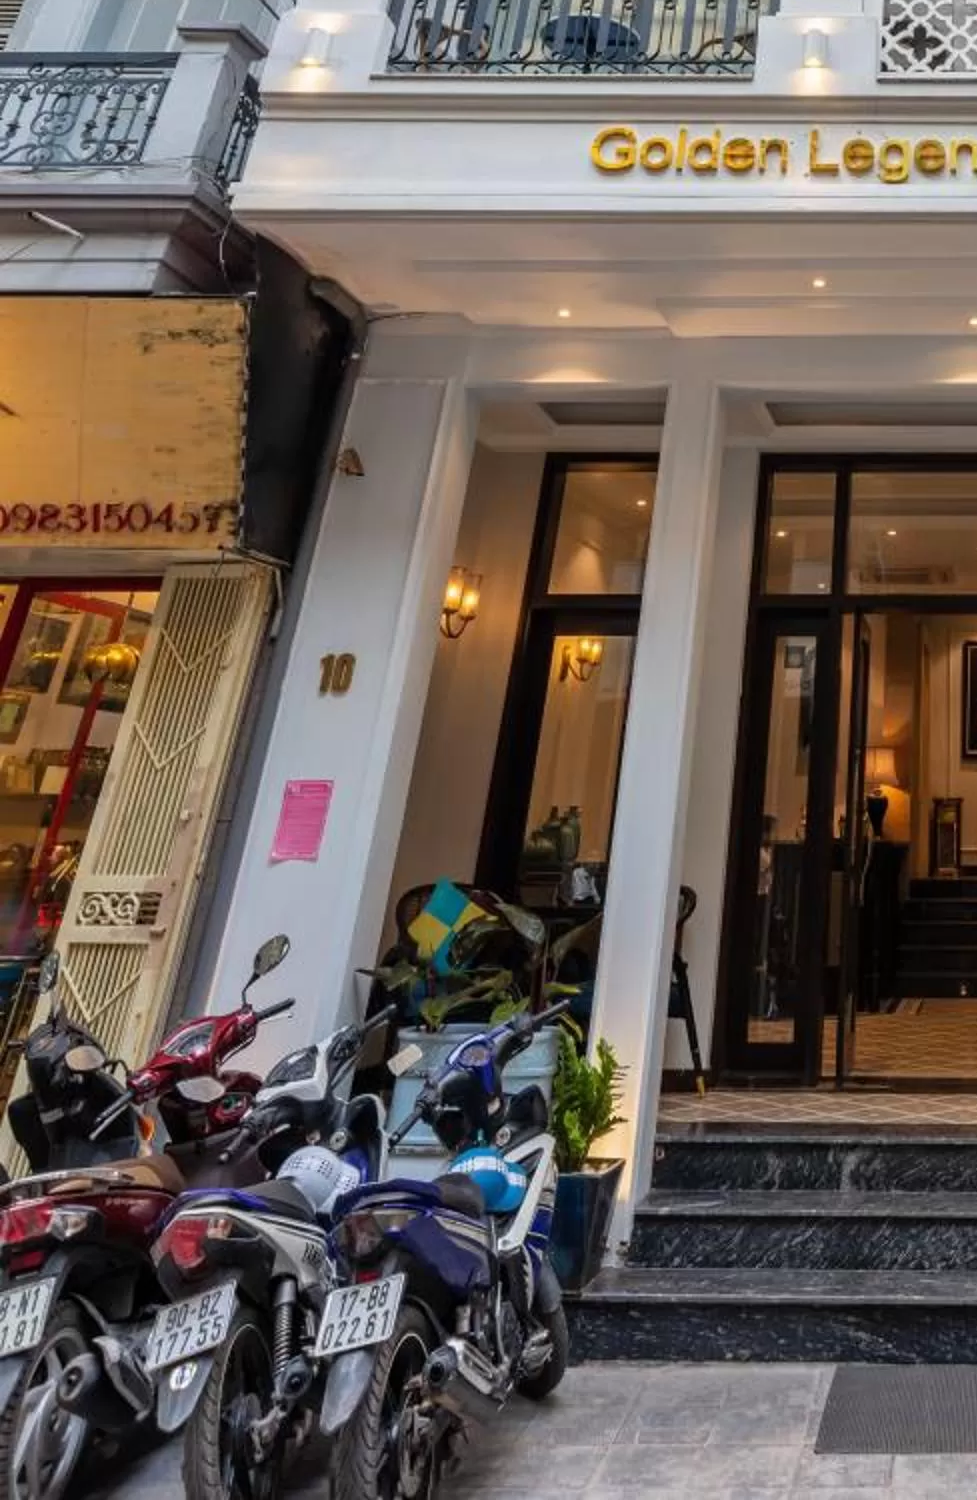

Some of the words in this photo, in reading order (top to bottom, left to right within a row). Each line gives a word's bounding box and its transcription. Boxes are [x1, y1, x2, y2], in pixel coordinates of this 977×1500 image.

[589, 127, 790, 174] Golden
[318, 652, 357, 697] 10
[321, 1310, 390, 1350] 022.61
